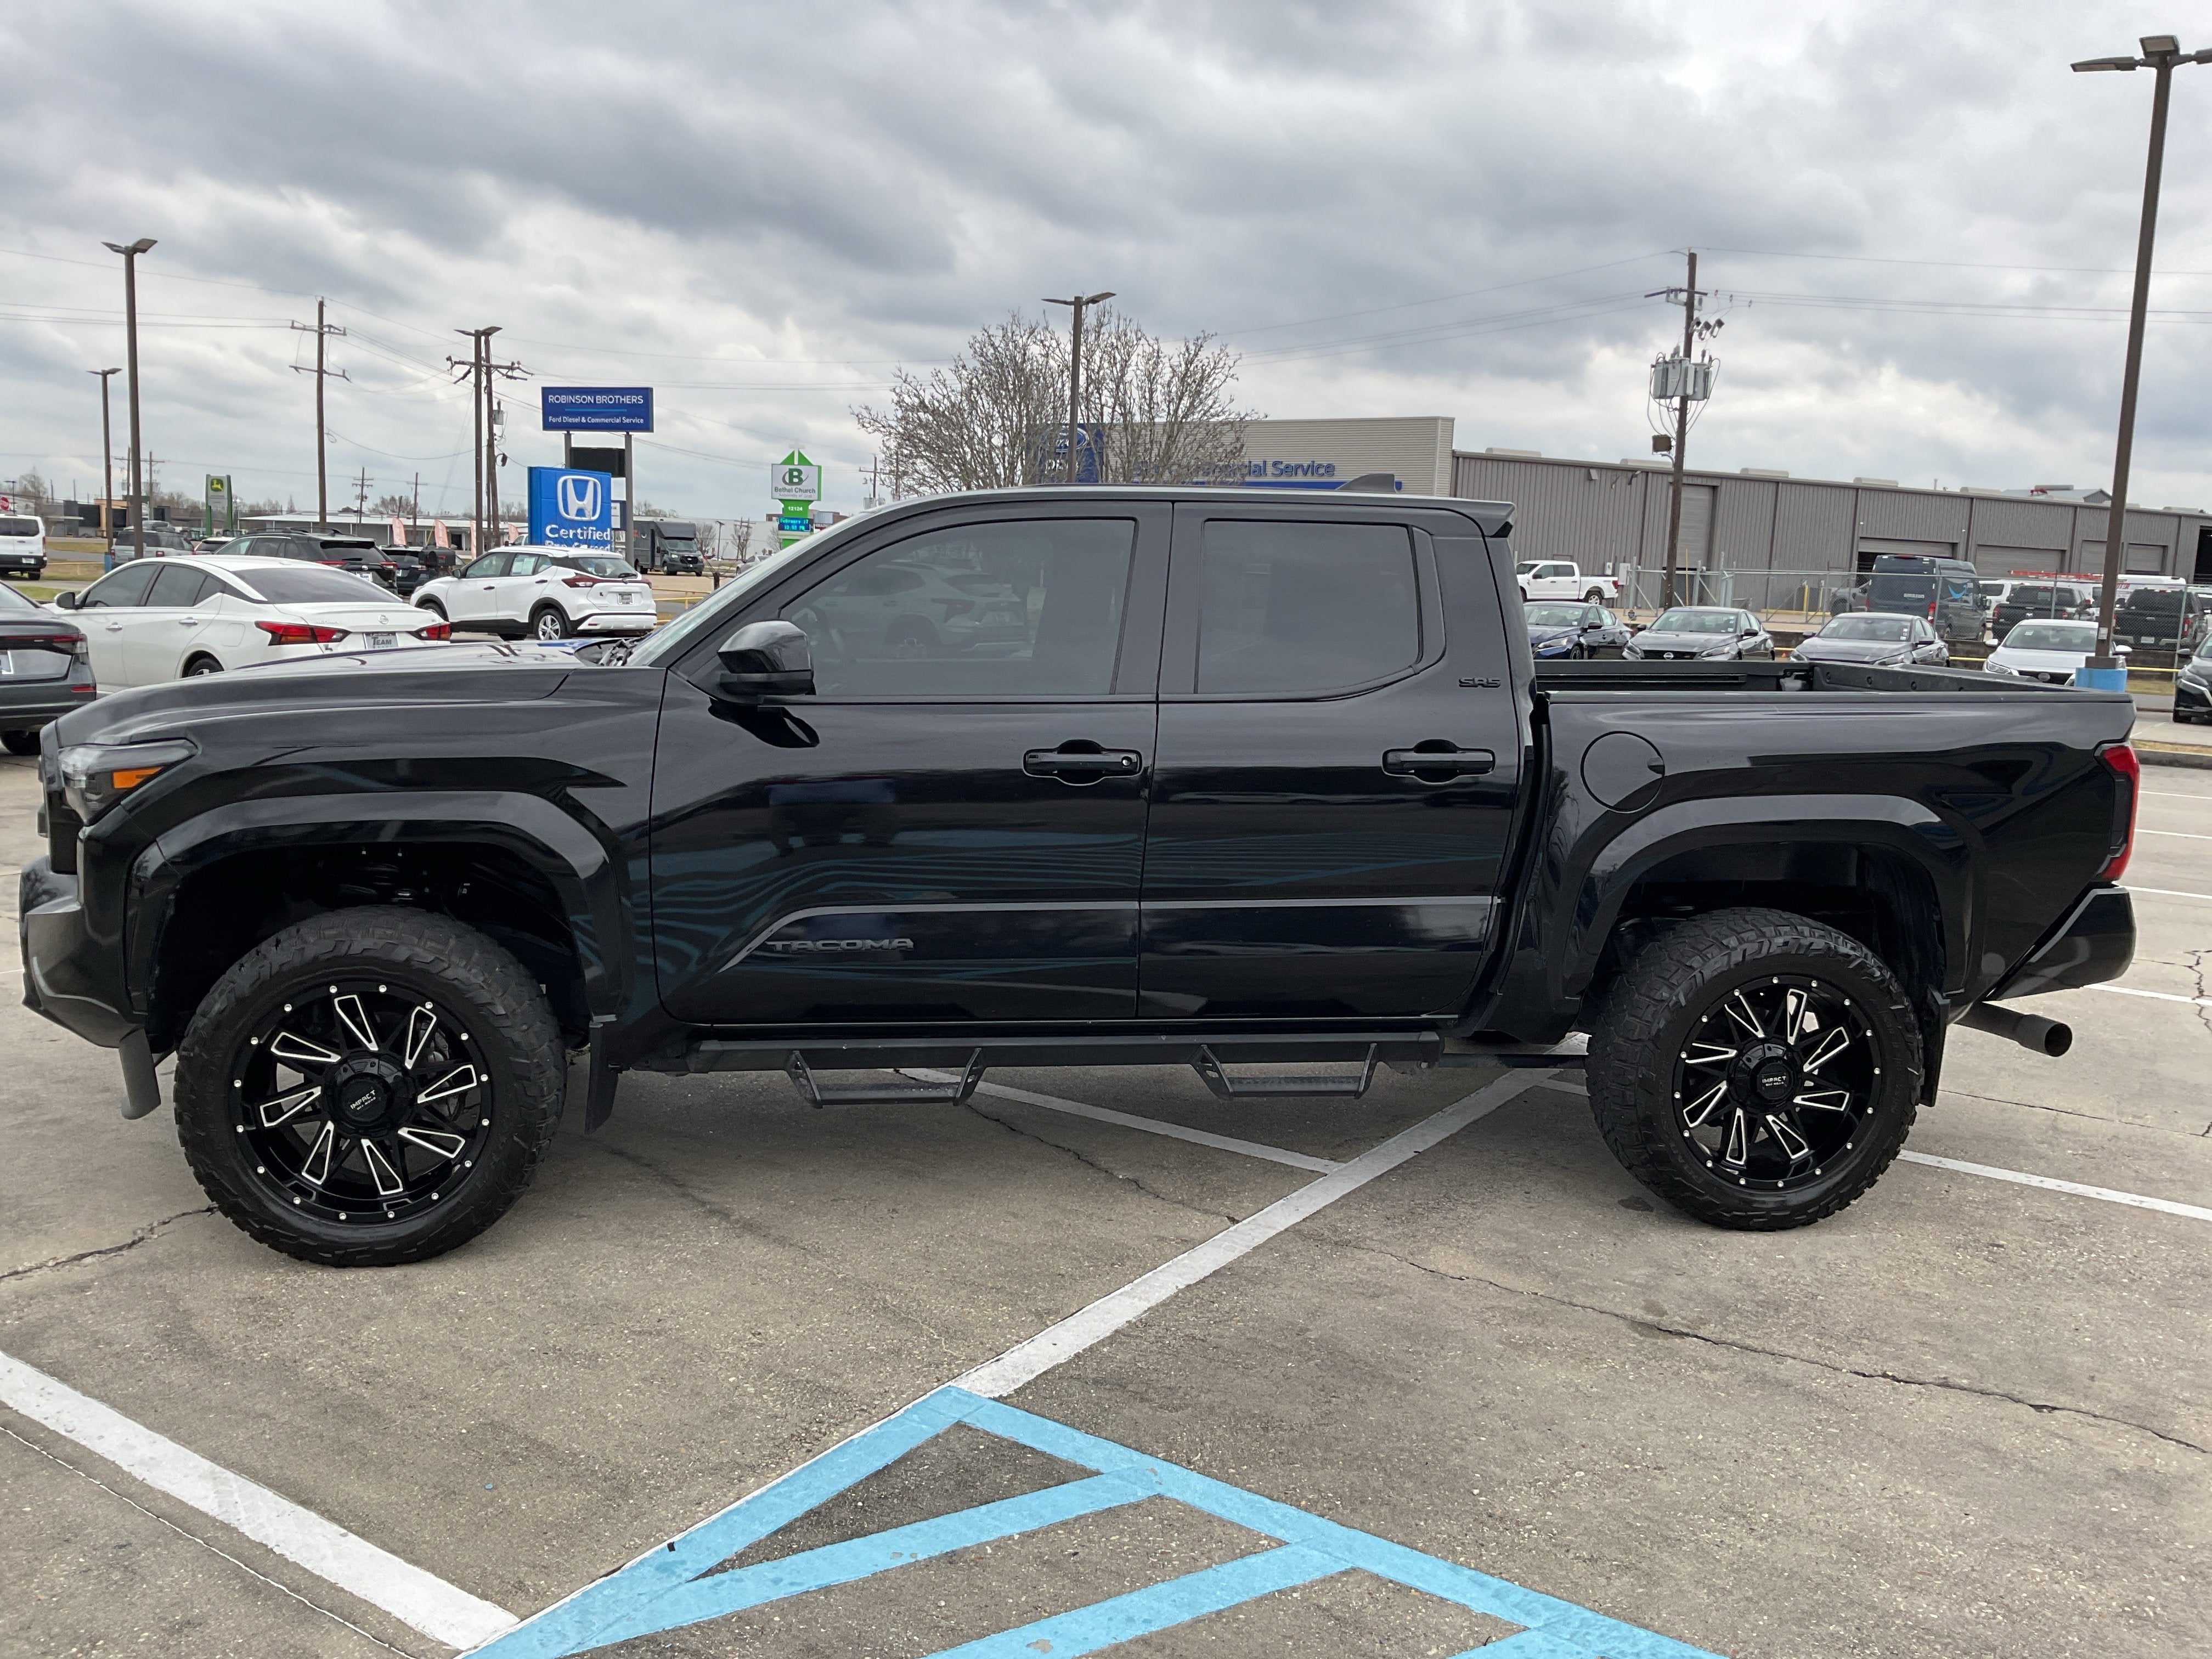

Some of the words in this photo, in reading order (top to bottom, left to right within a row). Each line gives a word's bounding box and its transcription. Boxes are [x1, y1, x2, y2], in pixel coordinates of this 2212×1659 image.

[549, 395, 594, 404] ROBINSON
[596, 396, 644, 404] BROTHERS
[1271, 460, 1335, 477] Service
[545, 524, 611, 540] Certified
[371, 636, 392, 645] TEAM
[1459, 677, 1501, 687] SR5
[765, 938, 915, 951] TACOMA
[350, 1090, 375, 1109] IMPACT
